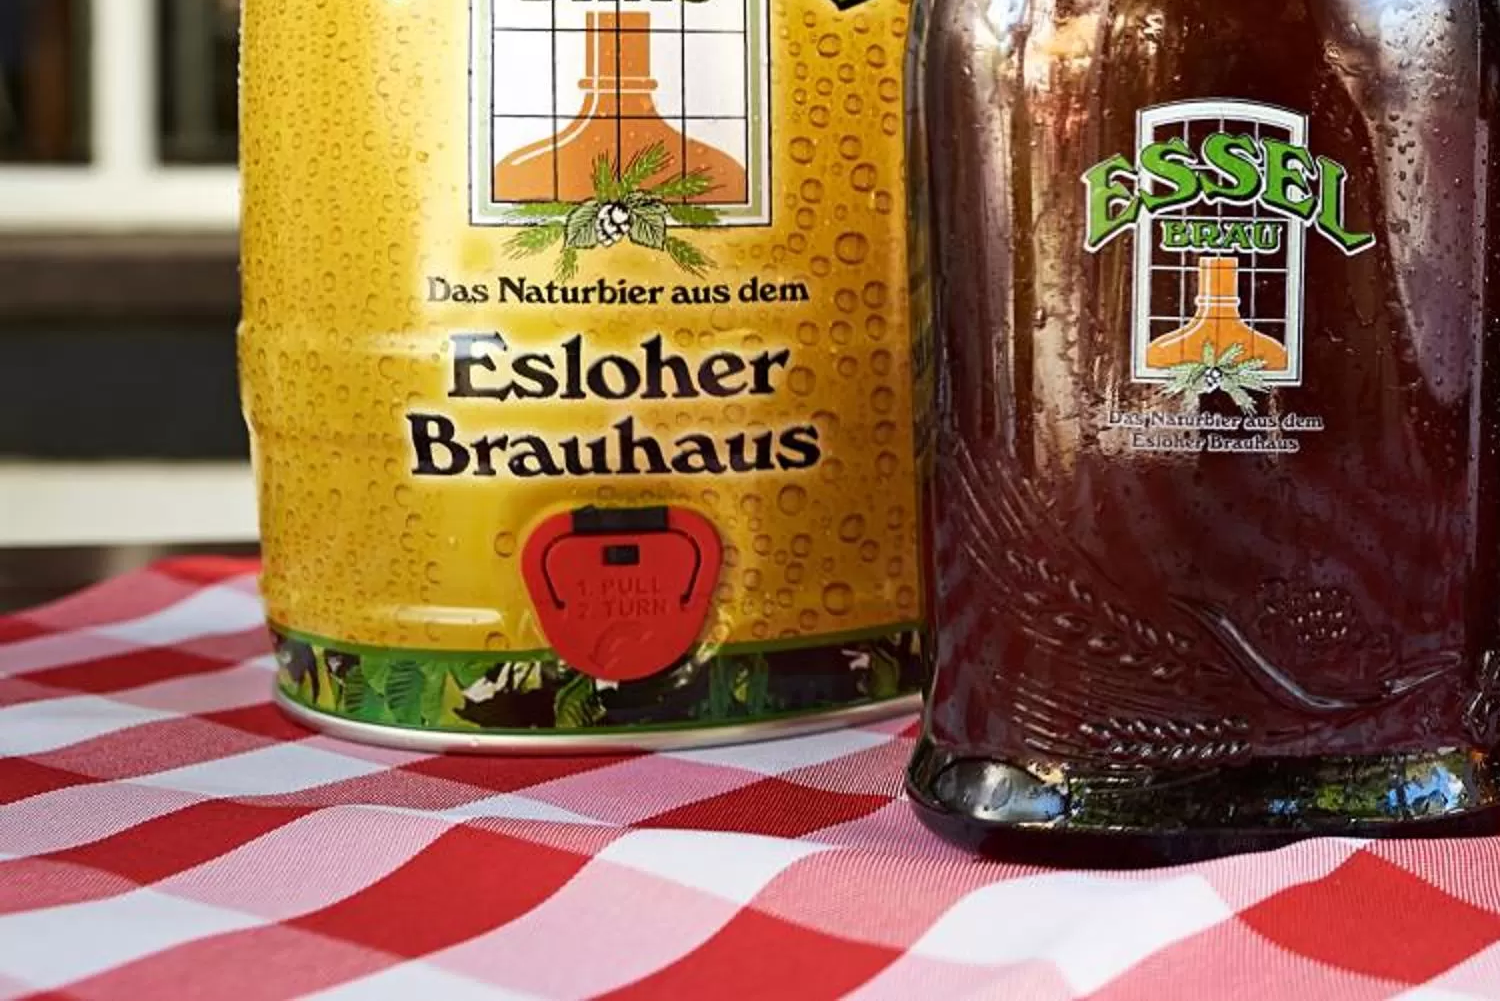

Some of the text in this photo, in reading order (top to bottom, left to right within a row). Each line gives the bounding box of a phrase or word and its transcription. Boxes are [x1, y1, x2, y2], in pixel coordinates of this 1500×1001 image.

[1081, 133, 1376, 255] ESSEL
[427, 276, 809, 305] Das Naturbier aus dem
[447, 331, 791, 400] Esloher
[406, 413, 821, 477] Brauhaus
